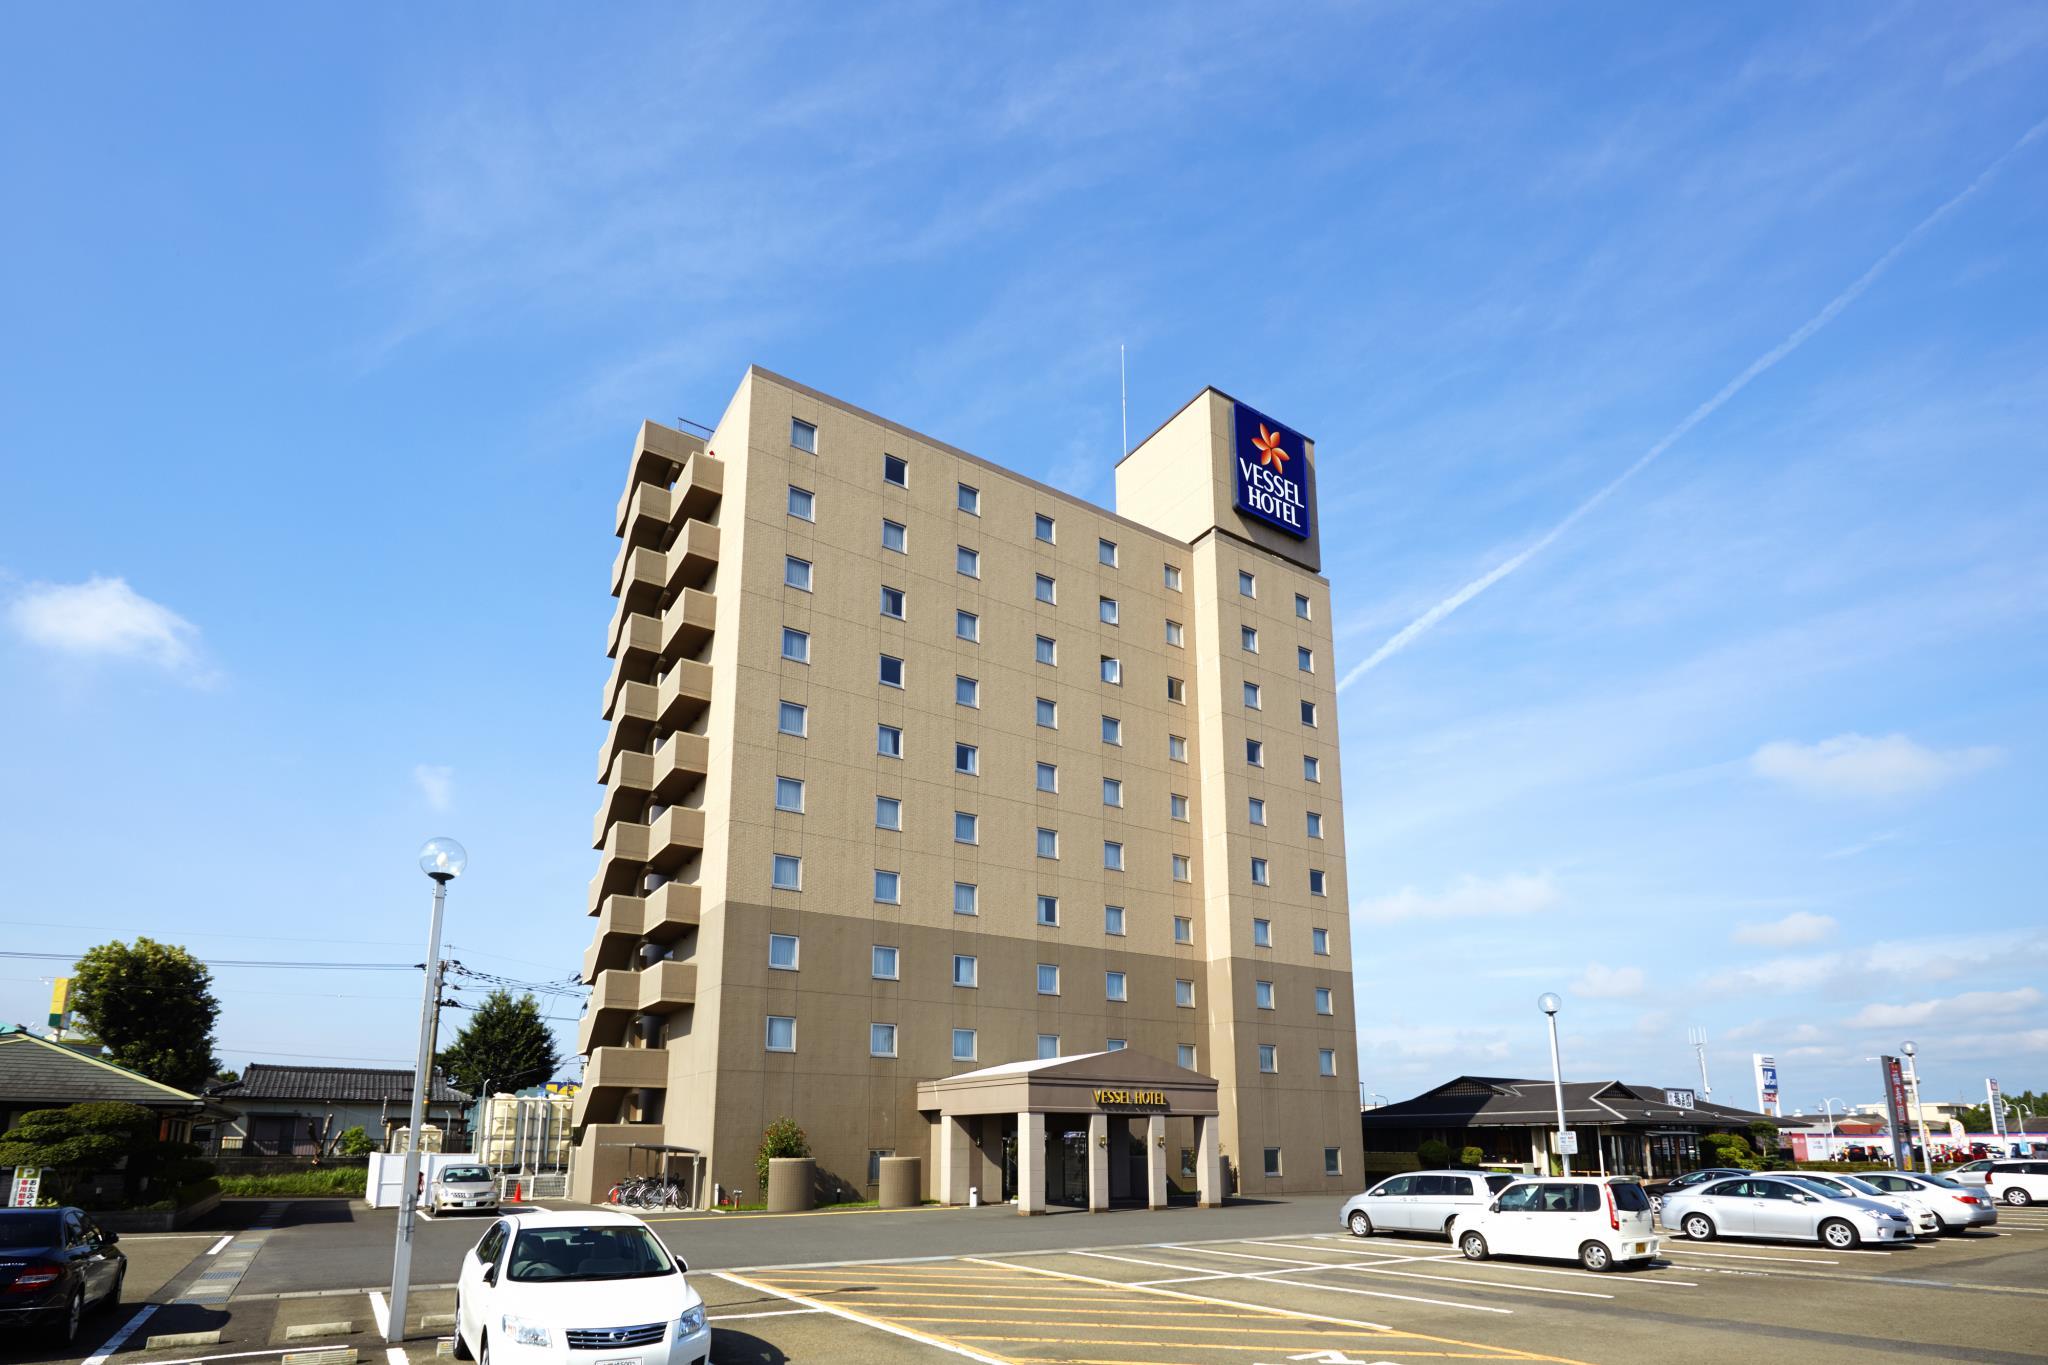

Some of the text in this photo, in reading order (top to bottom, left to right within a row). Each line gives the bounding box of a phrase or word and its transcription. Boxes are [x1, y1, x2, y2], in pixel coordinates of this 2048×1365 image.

[1240, 457, 1304, 508] VESSEL
[1248, 485, 1301, 528] HOTEL
[1092, 1088, 1167, 1105] VESSEL HOTEL
[23, 1168, 35, 1178] P
